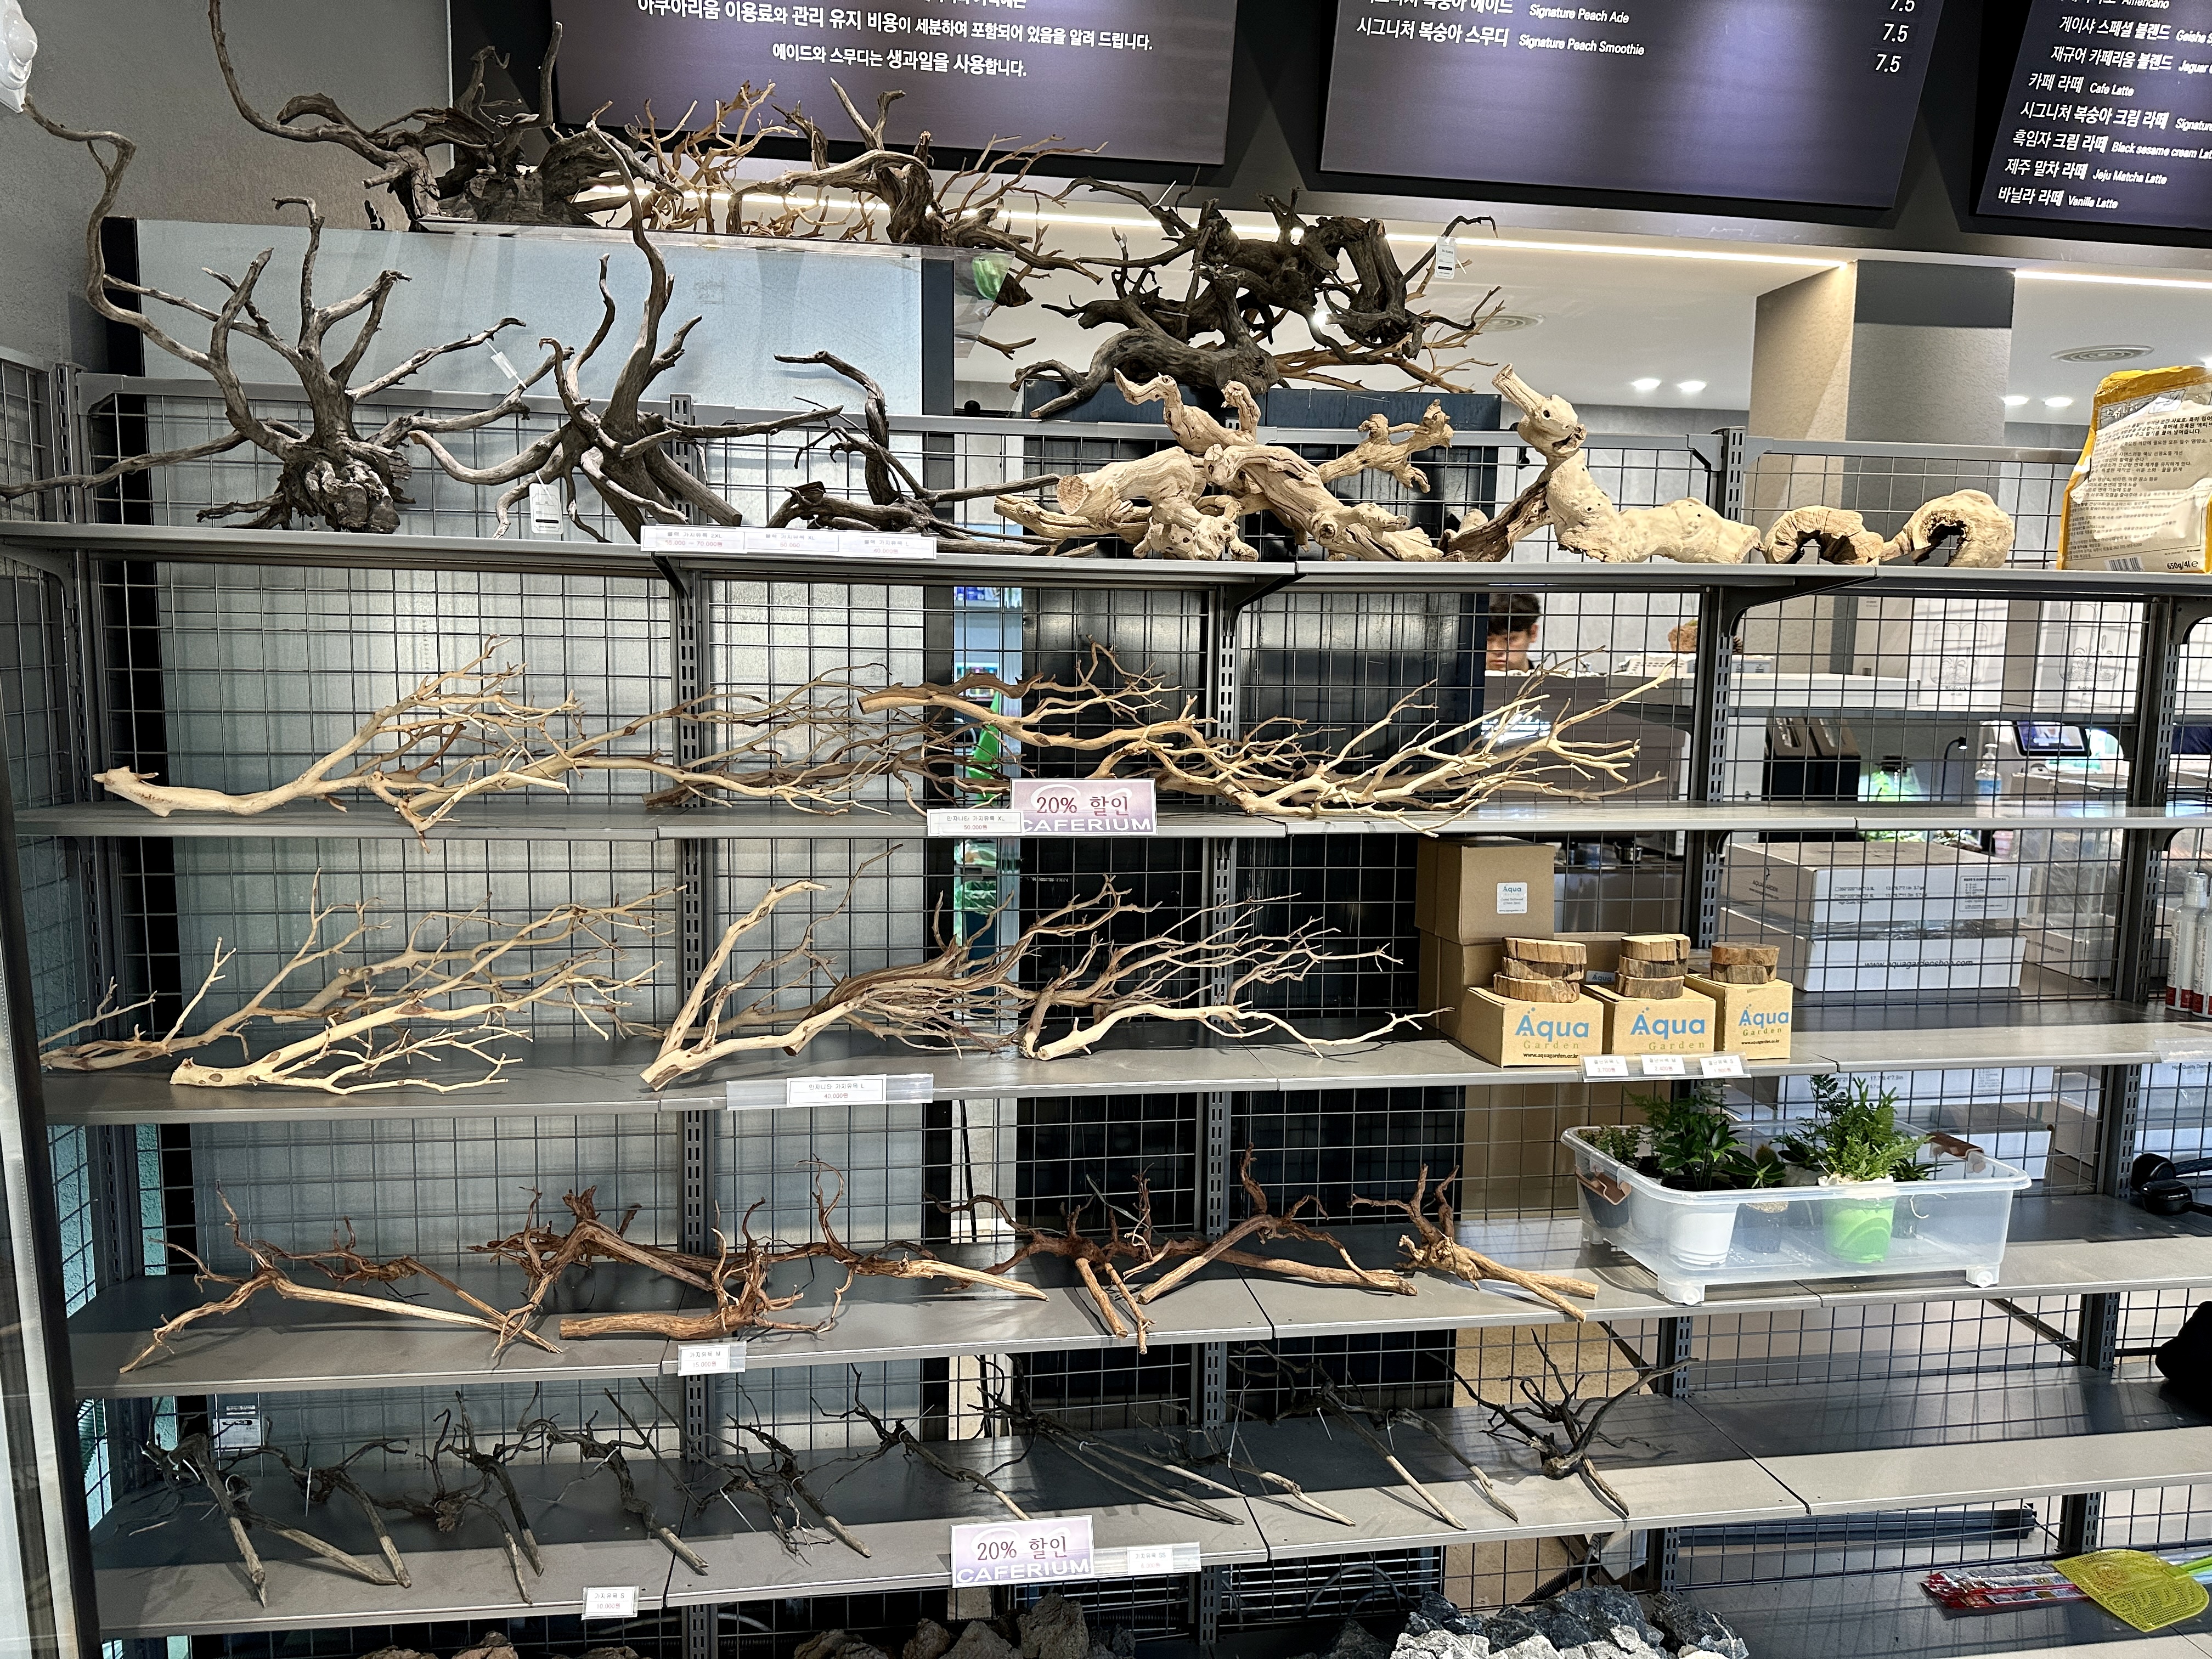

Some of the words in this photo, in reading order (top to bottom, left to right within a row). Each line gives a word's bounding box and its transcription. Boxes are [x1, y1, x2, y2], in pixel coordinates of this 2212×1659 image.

[1529, 3, 1576, 19] Signature
[1578, 8, 1607, 22] Peach
[1609, 11, 1629, 24] Ade
[1890, 0, 1915, 12] 7.5
[637, 0, 720, 20] 아쿠아리움
[725, 1, 788, 25] 이용료와
[792, 5, 823, 27] 관리
[829, 8, 861, 31] 유지
[867, 12, 911, 33] 비용이
[915, 18, 968, 37] 세분하여
[970, 22, 1023, 42] 포함되어
[1027, 26, 1066, 45] 있음을
[1069, 29, 1095, 47] 알려
[1098, 31, 1153, 51] 드립니다.
[1356, 16, 1415, 40] 시그니처
[1418, 21, 1463, 43] 복숭아
[1465, 26, 1509, 47] 스무디
[1883, 23, 1909, 42] 7.5
[2059, 16, 2096, 34] 게이샤
[2096, 19, 2134, 38] 스페셜
[1519, 33, 1565, 49] Signature
[1567, 38, 1597, 52] Peach
[1599, 41, 1645, 55] Smoothie
[2176, 29, 2206, 43] Geisha
[772, 43, 826, 63] 에이드와
[829, 47, 883, 67] 스무디는
[887, 49, 950, 72] 생과일을
[953, 54, 1028, 77] 사용합니다.
[1875, 53, 1901, 72] 7.5
[2051, 46, 2087, 64] 재규어
[2089, 49, 2135, 68] 카페리움
[2179, 60, 2209, 75] Jaguar
[2028, 73, 2056, 91] 카페
[2057, 75, 2085, 93] 라떼
[2090, 82, 2109, 95] Cafe
[2111, 84, 2135, 97] Latte
[2020, 101, 2072, 122] 시그니처
[2074, 106, 2113, 125] 복숭아
[2113, 109, 2141, 127] 크림
[2142, 111, 2170, 130] 라떼
[2012, 129, 2052, 148] 흑임자
[2052, 133, 2080, 151] 크림
[2082, 134, 2109, 154] 라떼
[2111, 141, 2136, 154] Black
[2136, 145, 2170, 156] sesame
[2170, 146, 2197, 158] cream
[2005, 158, 2030, 176] 제주
[2034, 160, 2059, 178] 말차
[2062, 162, 2089, 180] 라떼
[2092, 169, 2111, 180] Jeju
[2113, 170, 2144, 183] Matcha
[2145, 172, 2168, 185] Latte
[1997, 187, 2035, 205] 바닐라
[2038, 189, 2064, 207] 라떼
[2068, 195, 2095, 207] Vanilla
[2096, 196, 2118, 210] Latte
[1036, 797, 1077, 814] 20%
[1090, 795, 1129, 816] 할인
[1022, 818, 1151, 832] CAFERIUM
[1515, 1014, 1589, 1042] Aqua
[1630, 1014, 1705, 1040] Aqua
[1738, 1009, 1789, 1029] Aqua
[1743, 1028, 1781, 1036] Garden
[1523, 1040, 1579, 1049] Garden
[1649, 1041, 1705, 1050] Garden
[978, 1540, 1017, 1561] 20%
[1029, 1536, 1067, 1560] 할인
[957, 1559, 1090, 1583] CAFERIUM
